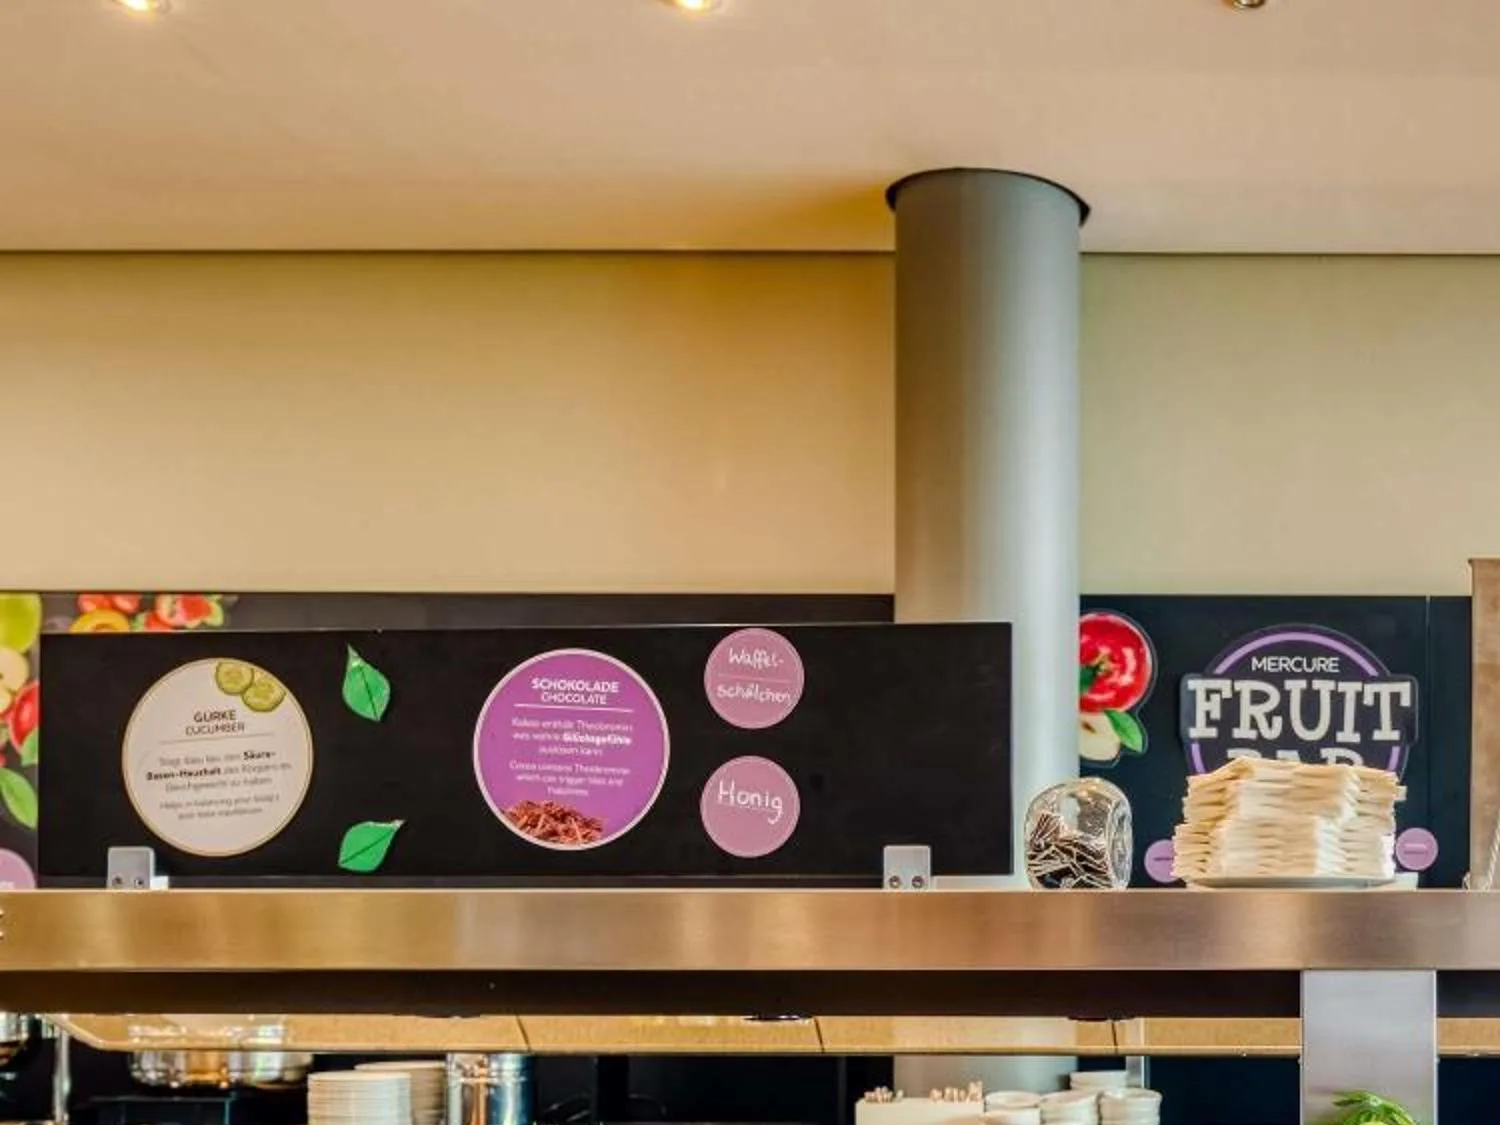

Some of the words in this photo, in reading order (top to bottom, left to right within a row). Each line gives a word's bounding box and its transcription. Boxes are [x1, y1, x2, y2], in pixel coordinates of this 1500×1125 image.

[728, 647, 784, 669] Waffel-
[1251, 656, 1341, 674] MERCURE
[531, 677, 621, 693] SCHOKOLADE
[541, 691, 608, 705] CHOCOLATE
[193, 709, 236, 723] GURKE
[1187, 679, 1412, 744] FRUIT
[185, 722, 245, 737] CUCUMBER
[717, 779, 783, 825] Honig
